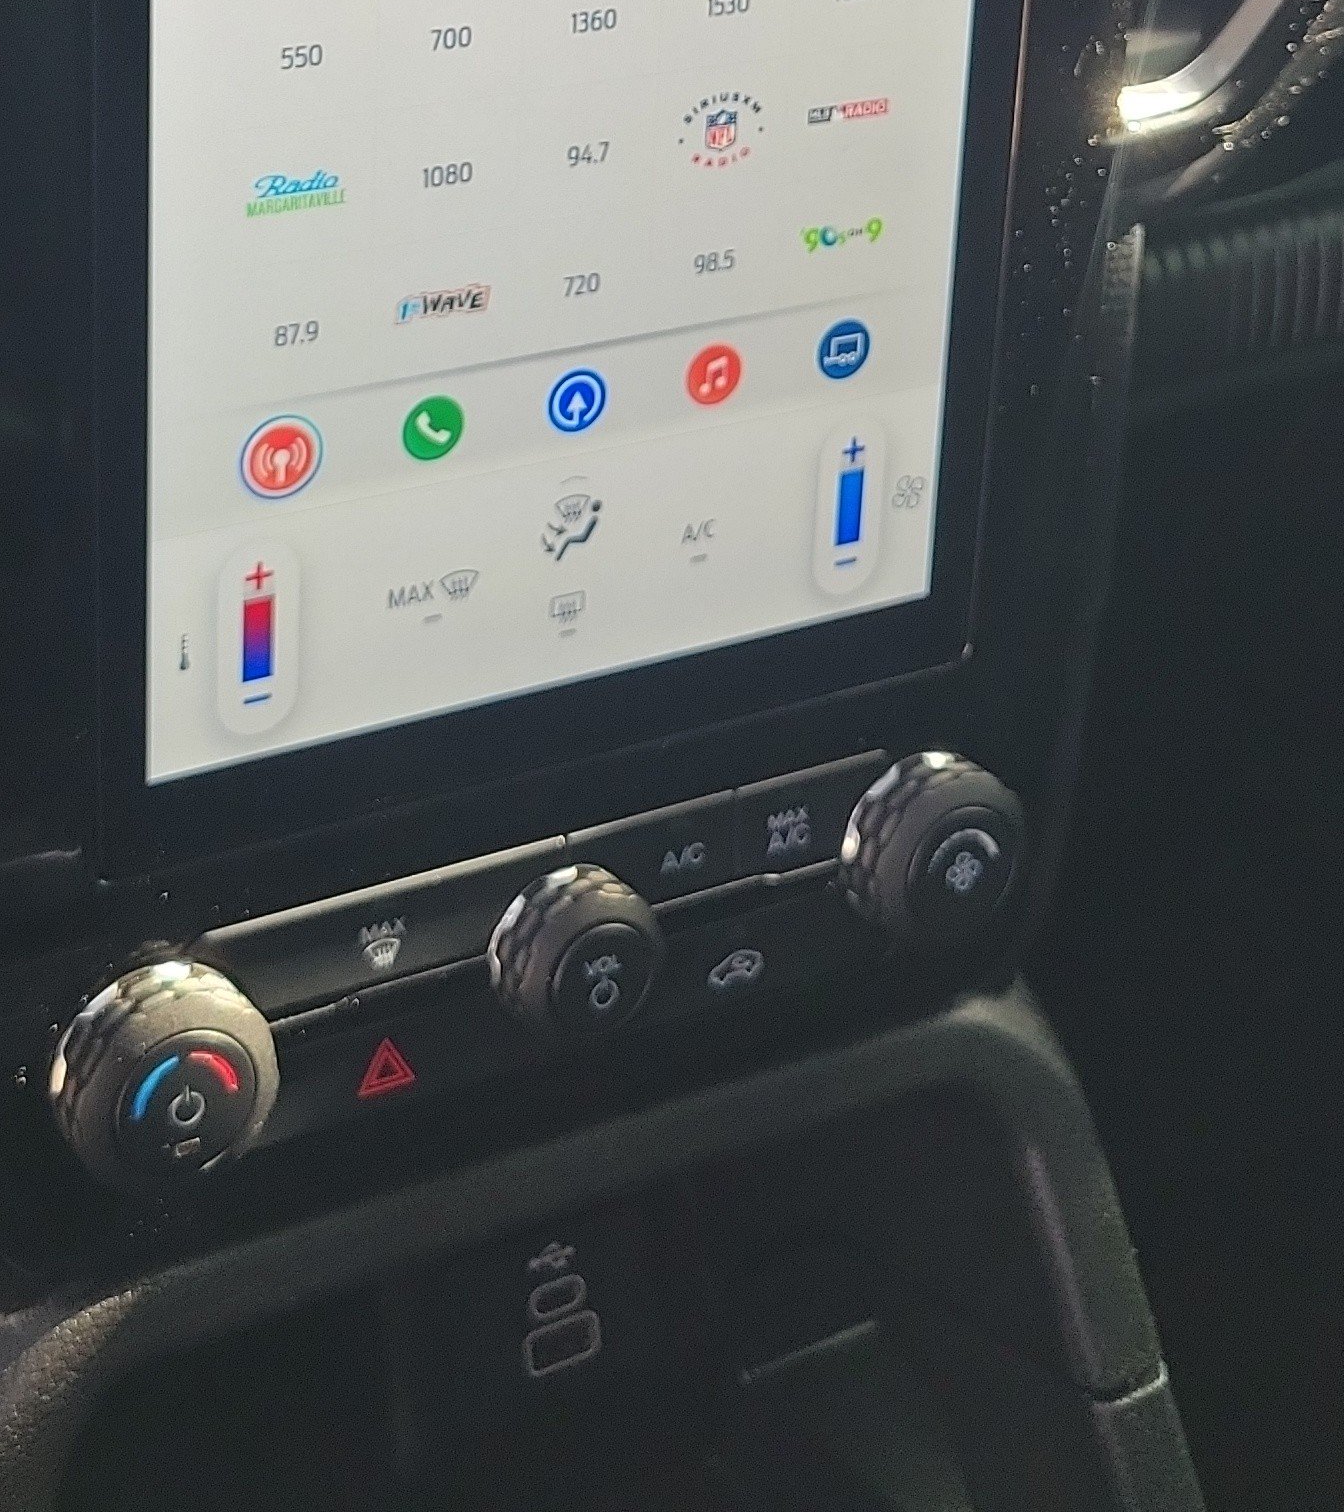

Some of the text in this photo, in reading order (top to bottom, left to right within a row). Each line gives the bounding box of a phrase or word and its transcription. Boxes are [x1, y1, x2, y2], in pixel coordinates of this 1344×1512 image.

[570, 8, 617, 36] 1360
[430, 25, 472, 51] 700
[280, 43, 323, 70] 550
[841, 98, 888, 120] RADIO
[567, 141, 610, 167] 94.7
[255, 169, 339, 198] Radio
[422, 161, 473, 190] 1080
[693, 248, 736, 276] 98.5
[563, 272, 601, 298] 720
[274, 320, 320, 348] 87.9
[682, 519, 716, 545] A/C
[388, 580, 435, 609] MAX
[767, 806, 809, 830] MAX
[660, 842, 705, 875] A/C
[359, 917, 406, 945] MAX
[583, 954, 622, 981] VOL
